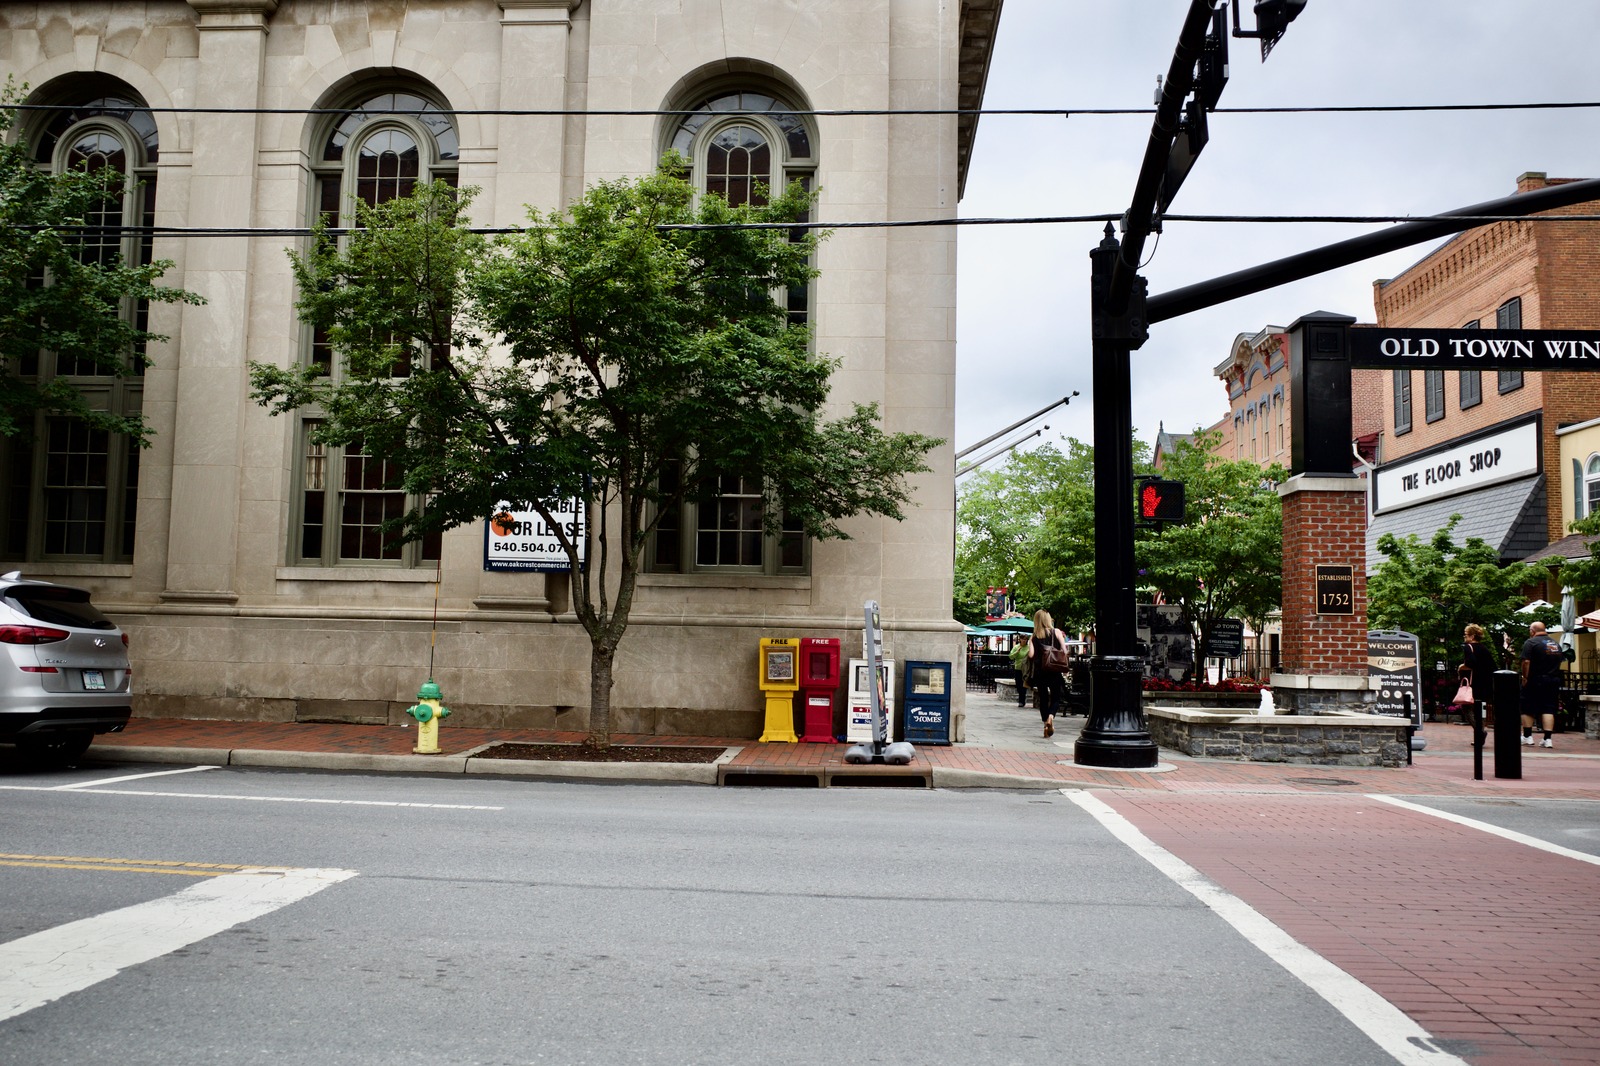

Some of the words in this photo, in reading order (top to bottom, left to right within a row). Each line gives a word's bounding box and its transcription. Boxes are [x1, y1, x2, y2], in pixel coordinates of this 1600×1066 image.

[1380, 338, 1440, 357] OLD
[1449, 338, 1534, 359] TOWN
[1543, 340, 1600, 359] WIN
[1402, 472, 1418, 492] THE
[1425, 460, 1461, 485] FLOOR
[1469, 447, 1502, 473] SHOP
[1322, 593, 1349, 606] 1752
